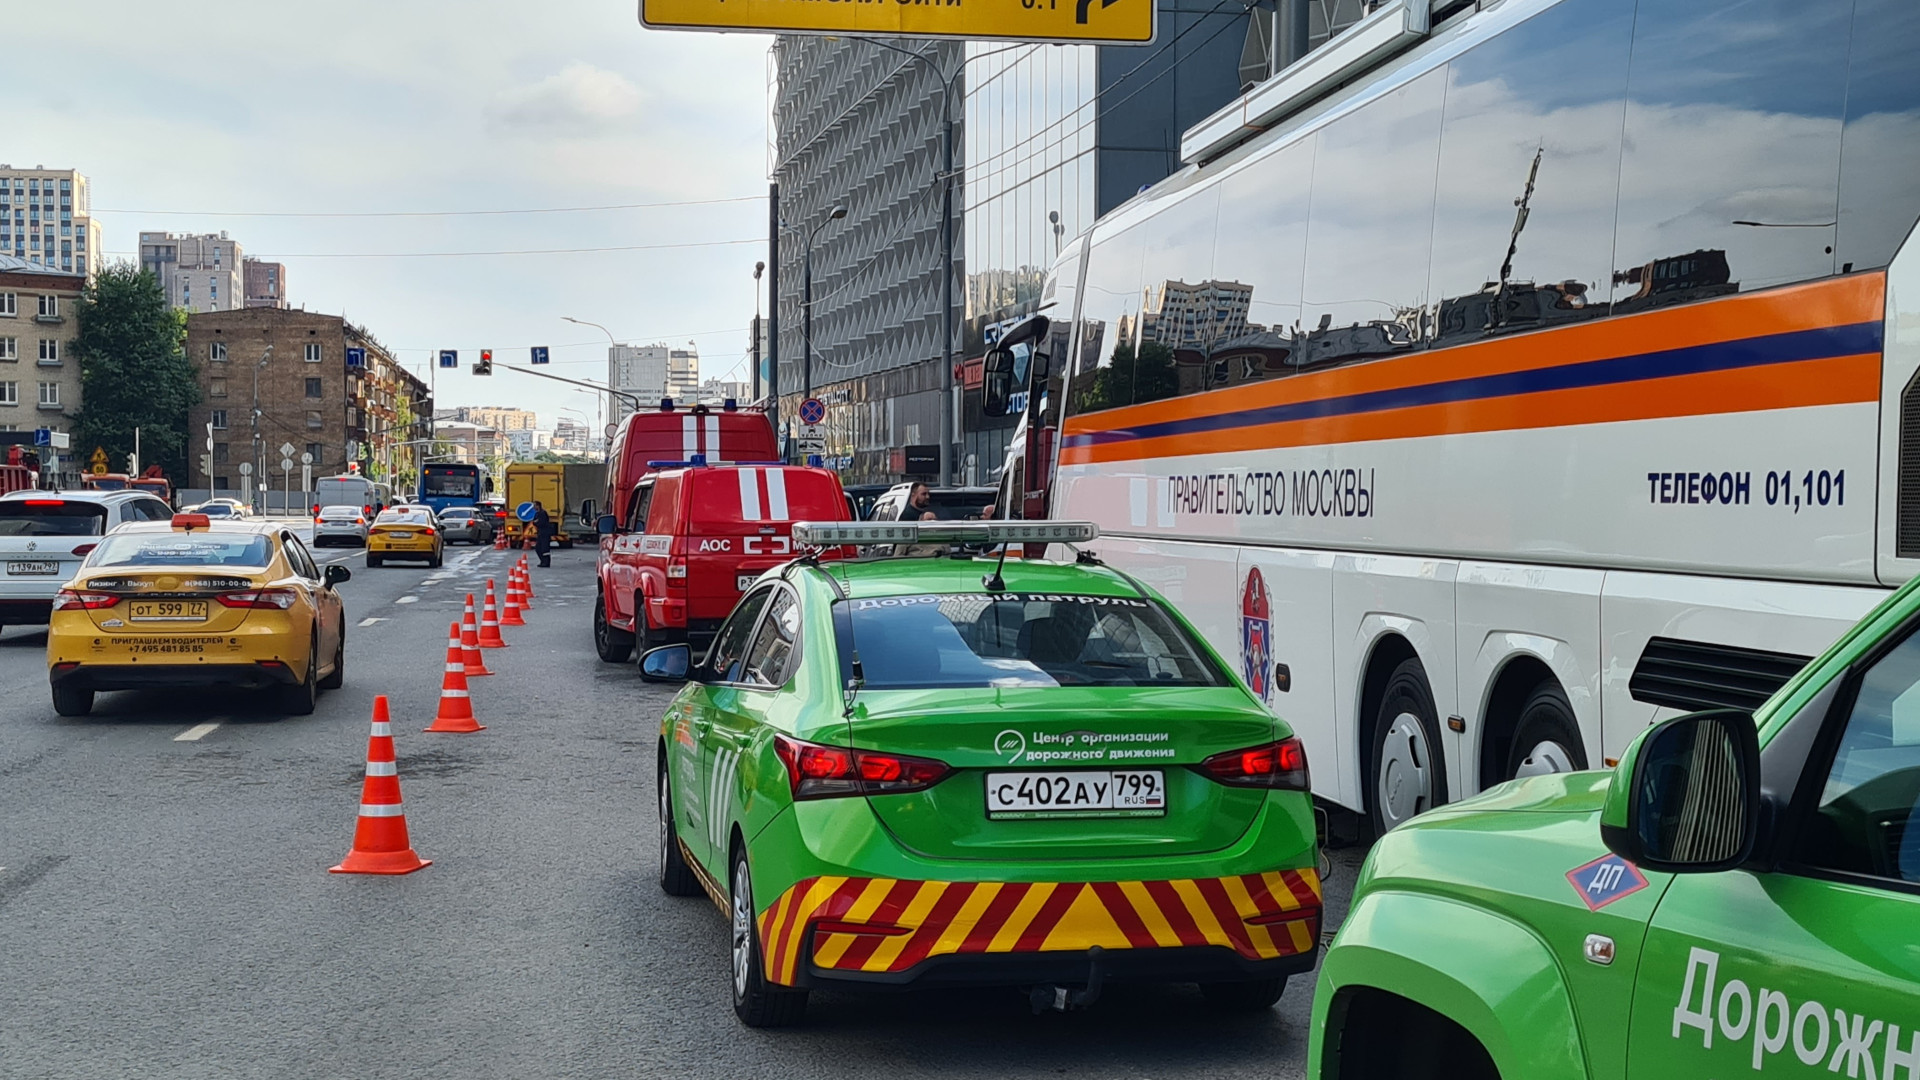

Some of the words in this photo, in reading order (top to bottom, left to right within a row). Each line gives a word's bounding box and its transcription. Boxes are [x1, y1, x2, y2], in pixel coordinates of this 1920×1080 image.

[1167, 471, 1286, 516] ПРАВИТЕЛЬСТВО
[1291, 467, 1375, 518] МОСКВЫ
[1647, 471, 1751, 505] ТЕЛЕФОН
[1765, 469, 1845, 515] 01,101
[699, 539, 731, 552] АОС
[88, 580, 117, 588] Лизинг
[127, 580, 154, 588] Выкуп
[858, 592, 1020, 610] Дорожный
[1027, 593, 1148, 607] патруль
[136, 605, 152, 615] ОТ
[158, 603, 183, 615] 599
[172, 637, 224, 645] ВОДИТЕЛЕЙ
[141, 645, 159, 653] 495
[1033, 732, 1074, 746] Центр
[1081, 732, 1168, 746] организации
[1026, 750, 1104, 762] дорожного
[1109, 748, 1175, 760] движения
[997, 776, 1109, 806] С402АУ
[1113, 774, 1156, 797] 799
[1124, 796, 1145, 805] RUS
[1586, 863, 1626, 895] ДП
